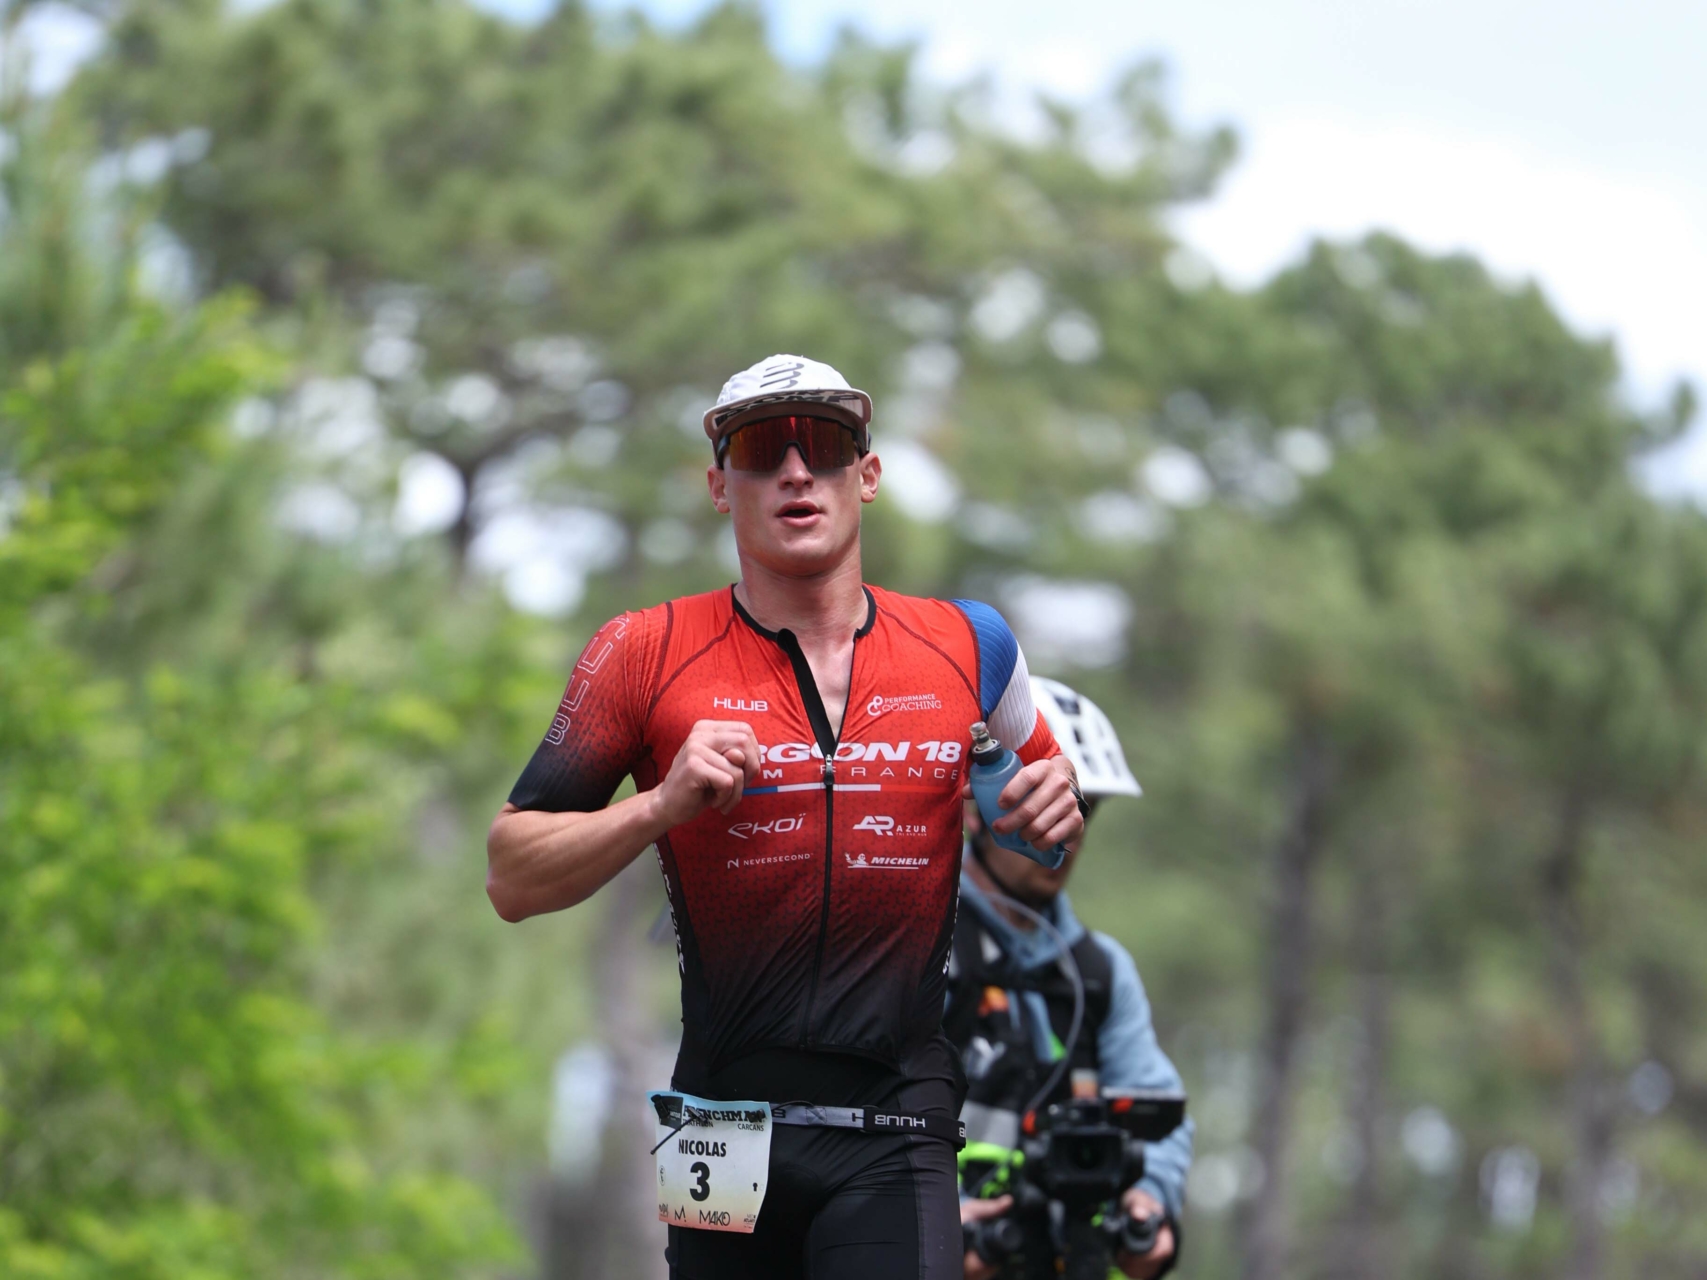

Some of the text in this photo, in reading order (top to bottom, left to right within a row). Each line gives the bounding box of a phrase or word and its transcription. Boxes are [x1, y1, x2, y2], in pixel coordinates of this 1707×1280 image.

[713, 696, 769, 712] HUUB
[884, 693, 936, 704] PERFORMANCE
[882, 700, 942, 712] COACHING
[758, 741, 962, 763] RGON 18
[819, 766, 959, 780] FRANCE
[896, 825, 927, 833] AZUR
[743, 853, 811, 866] NEVERSECOND
[871, 856, 930, 865] MICHELIN
[737, 1123, 765, 1132] CARCANS
[874, 1114, 926, 1128] HUUB
[678, 1139, 727, 1157] NICOLAS
[689, 1161, 710, 1202] 3
